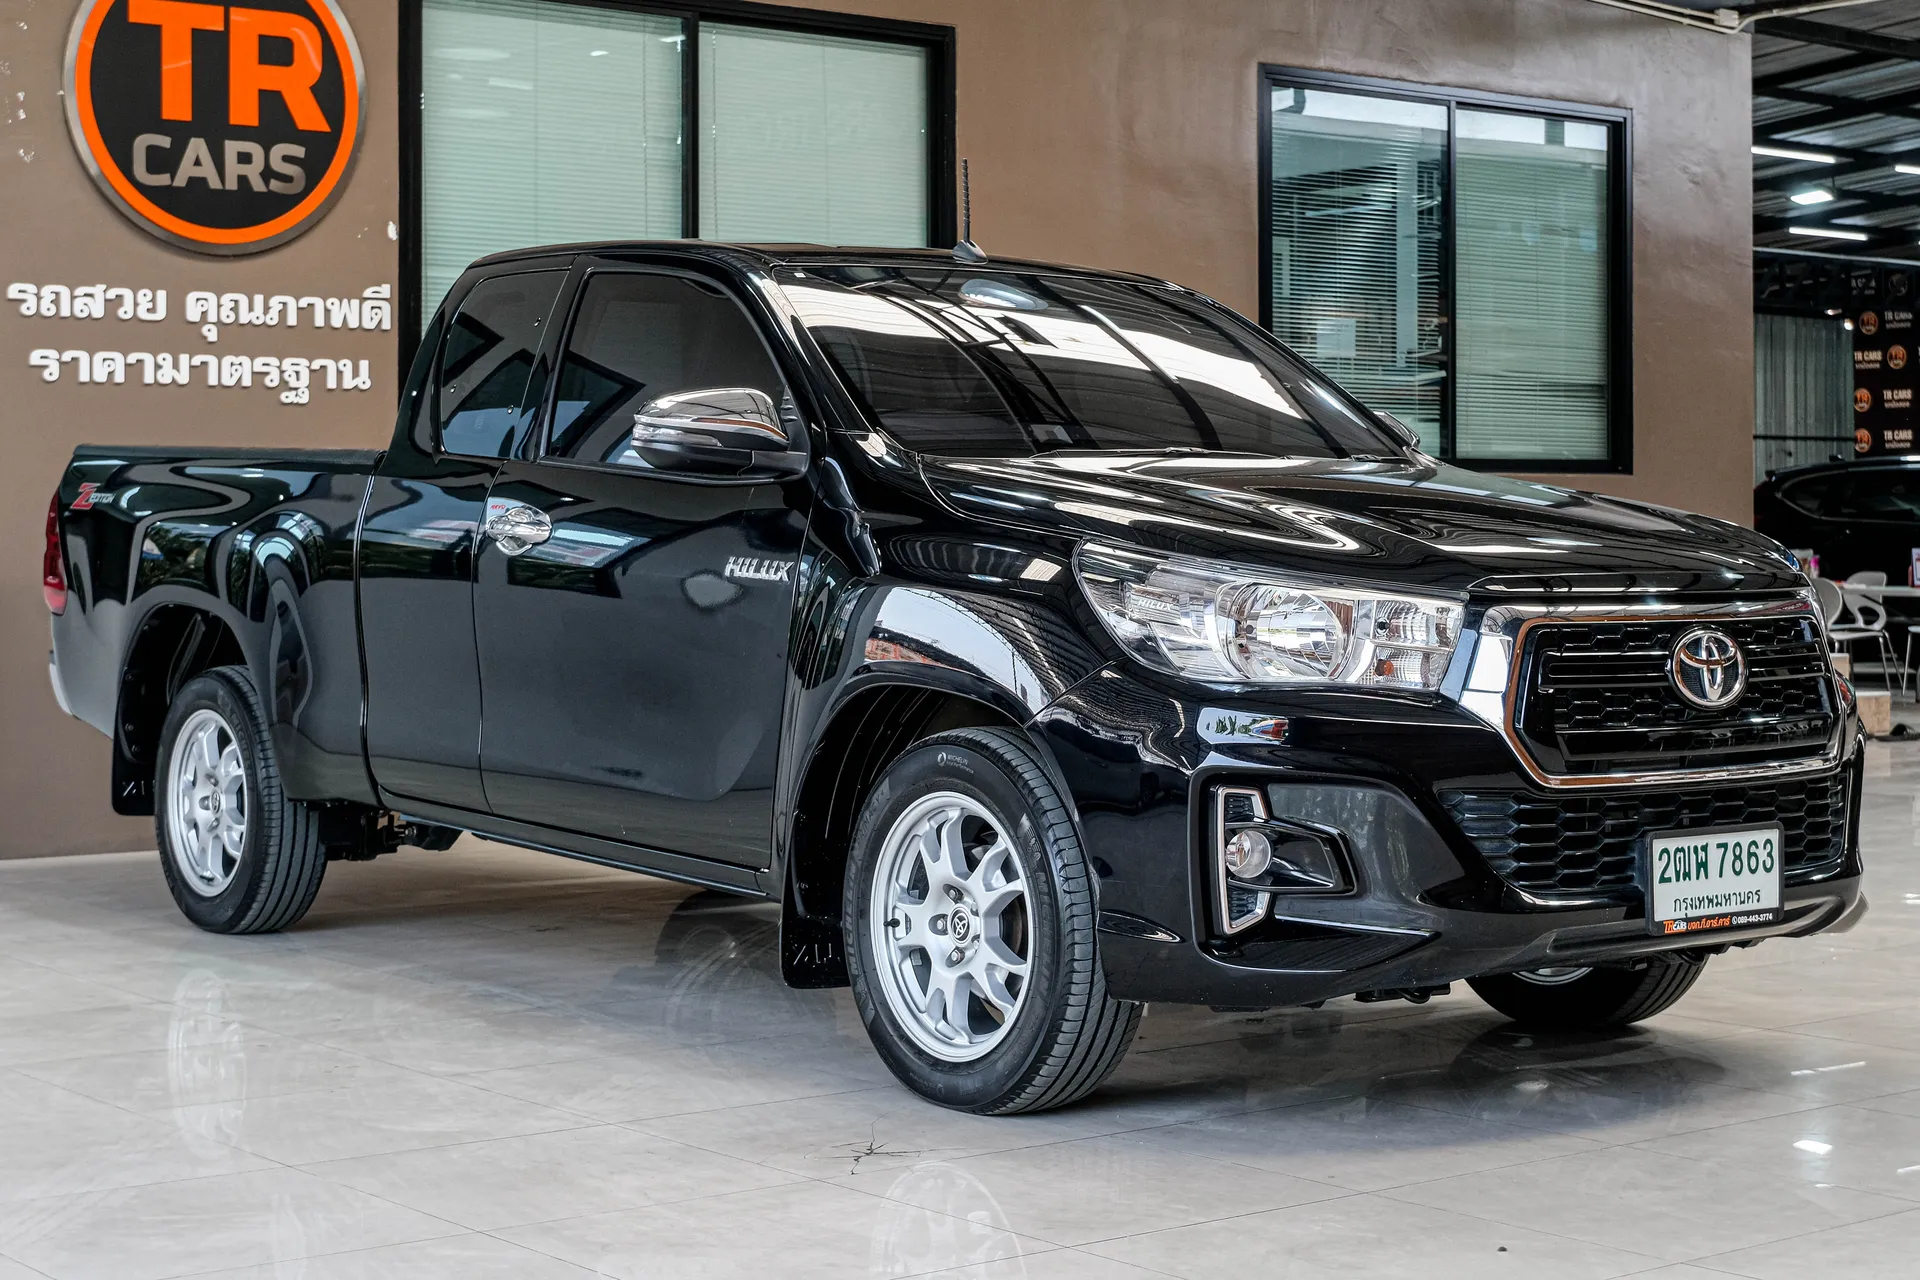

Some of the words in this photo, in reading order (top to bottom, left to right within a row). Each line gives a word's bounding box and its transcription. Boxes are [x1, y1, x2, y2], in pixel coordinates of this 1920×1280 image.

[127, 0, 332, 132] TR
[132, 133, 307, 195] CARS
[7, 282, 167, 322] รถสวย
[185, 284, 392, 342] คุณภาพดี
[1854, 350, 1863, 361] TR
[1863, 350, 1882, 361] CARS
[29, 348, 372, 404] ราคามาตรฐาน
[1883, 389, 1893, 400] TR
[1893, 388, 1912, 400] CARS
[1883, 430, 1893, 441] TR
[1893, 429, 1913, 441] CARS
[725, 556, 795, 582] HILUX
[1138, 599, 1174, 611] HILUX
[1716, 838, 1775, 878] 7863
[844, 861, 859, 976] MICHELIN
[1673, 889, 1761, 918] กรุงเทพมหานคร
